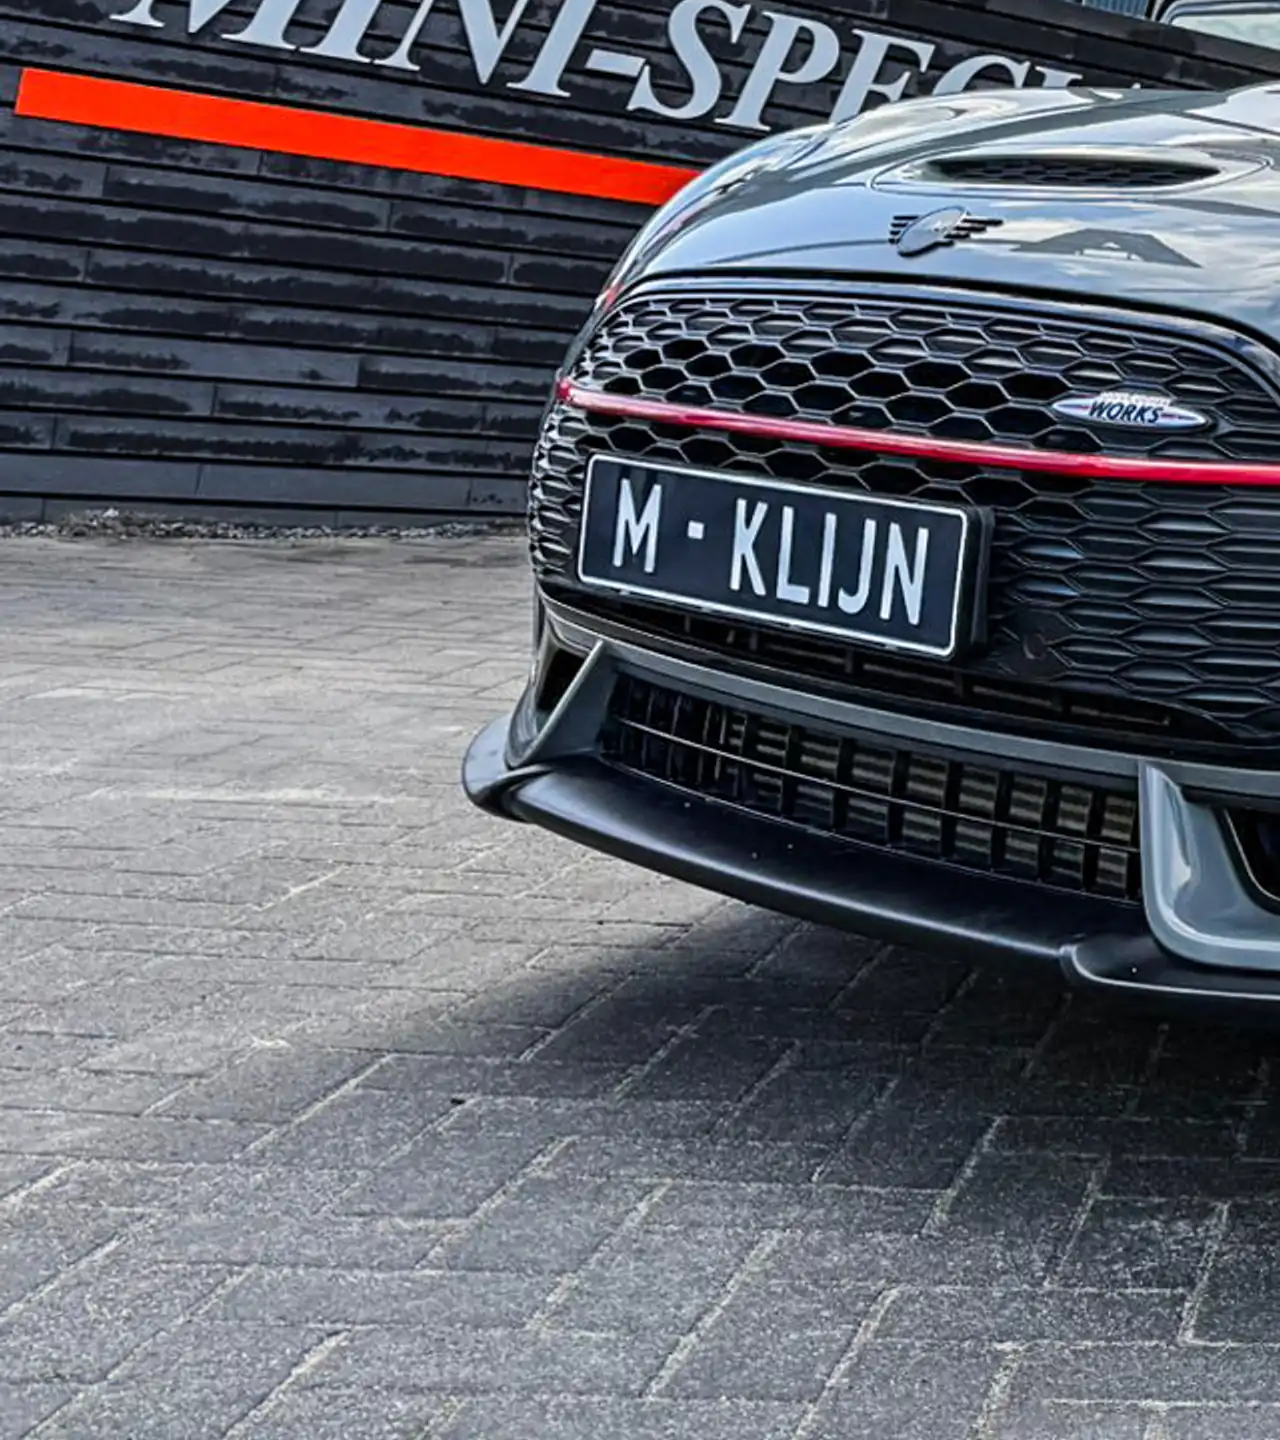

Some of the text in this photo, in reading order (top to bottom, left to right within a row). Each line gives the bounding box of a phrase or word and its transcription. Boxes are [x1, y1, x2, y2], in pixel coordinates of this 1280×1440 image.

[1088, 401, 1164, 424] WORKS
[610, 475, 663, 574] M
[728, 496, 930, 627] KLIJN
